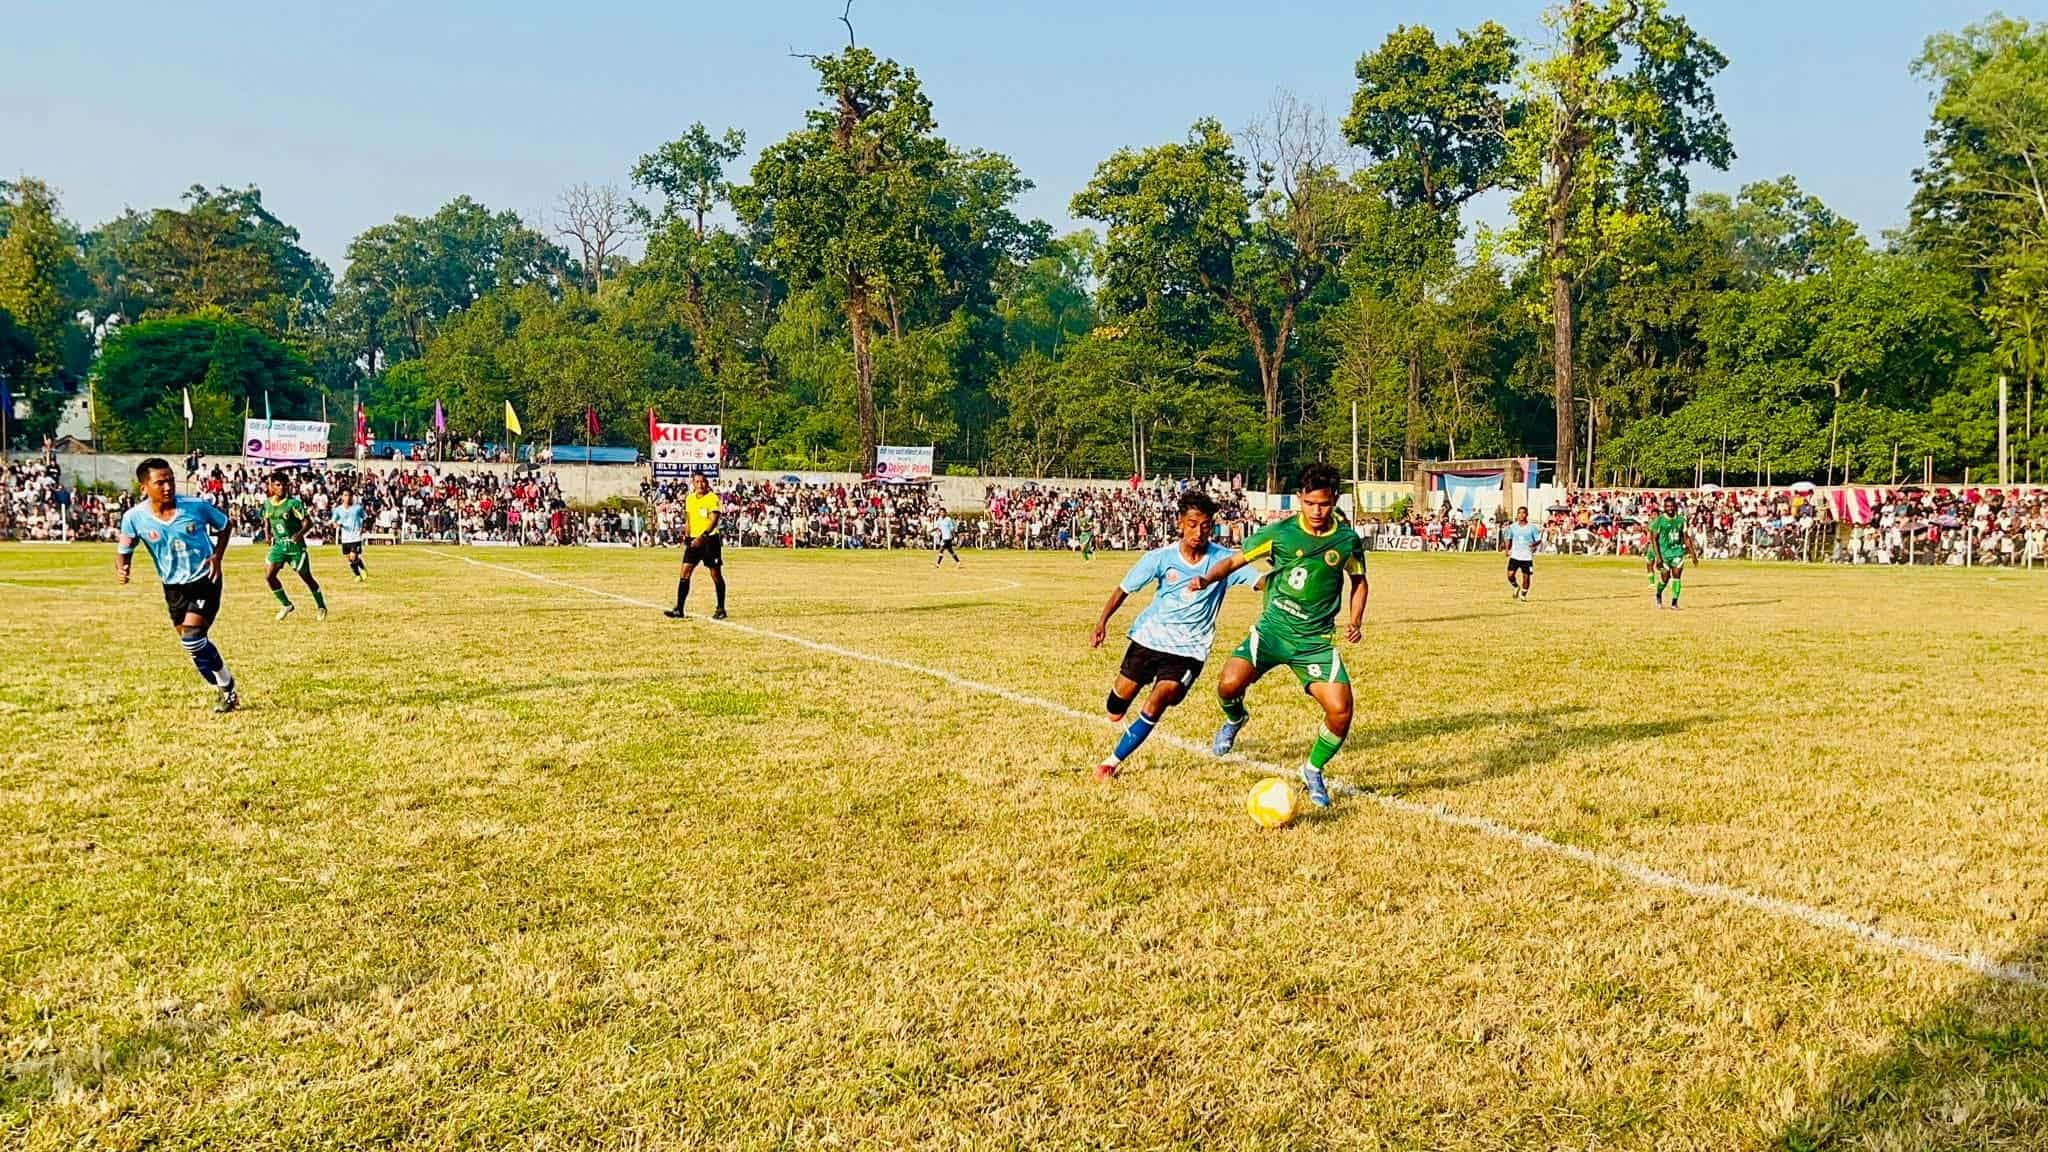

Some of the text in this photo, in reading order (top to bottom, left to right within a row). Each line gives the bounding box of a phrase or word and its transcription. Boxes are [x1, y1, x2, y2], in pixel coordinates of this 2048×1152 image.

[655, 427, 707, 442] KIEC
[299, 441, 326, 453] Paints
[1387, 537, 1420, 549] KIEC
[1288, 566, 1308, 591] 8
[1307, 664, 1322, 678] 8
